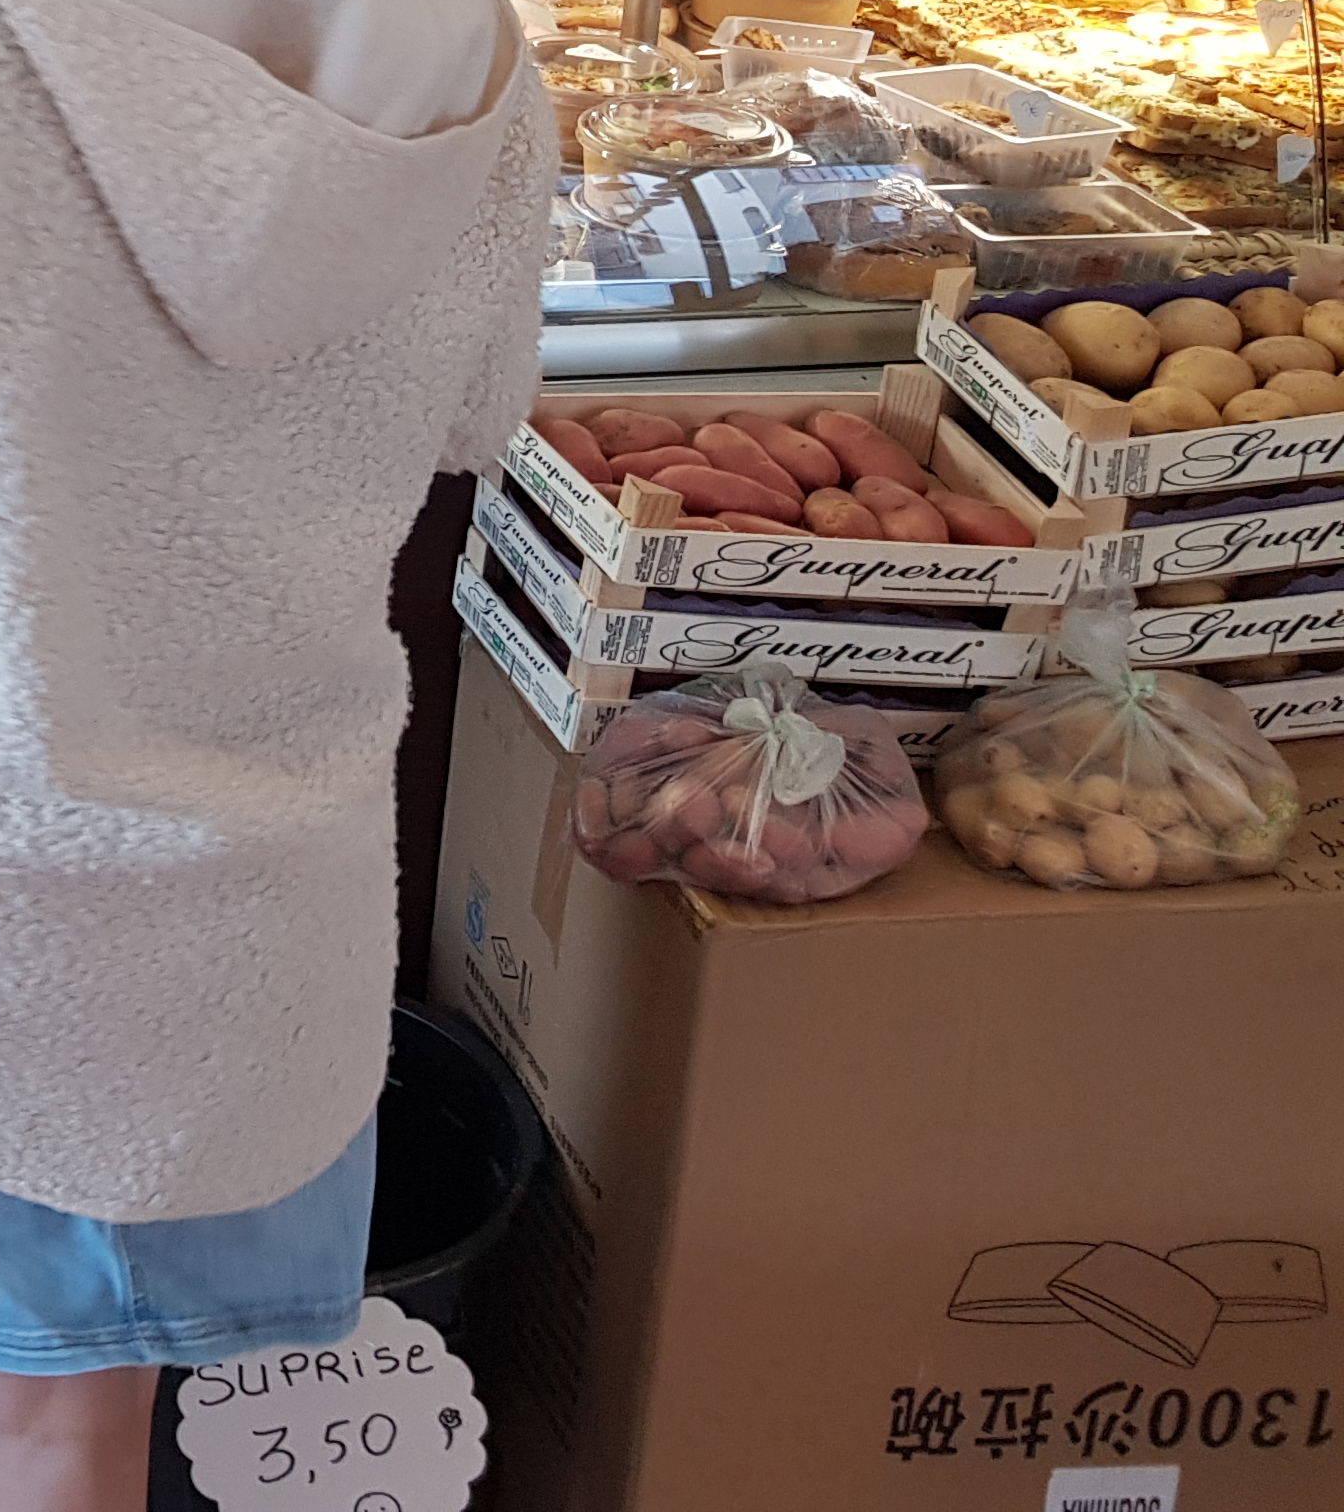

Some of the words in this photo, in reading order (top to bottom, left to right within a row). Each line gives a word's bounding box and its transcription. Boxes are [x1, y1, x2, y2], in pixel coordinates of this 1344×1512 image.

[939, 329, 1037, 421] Guaperal
[693, 539, 999, 588] Guaperal
[660, 621, 971, 669] Guaperal
[252, 1413, 397, 1483] 3,50
